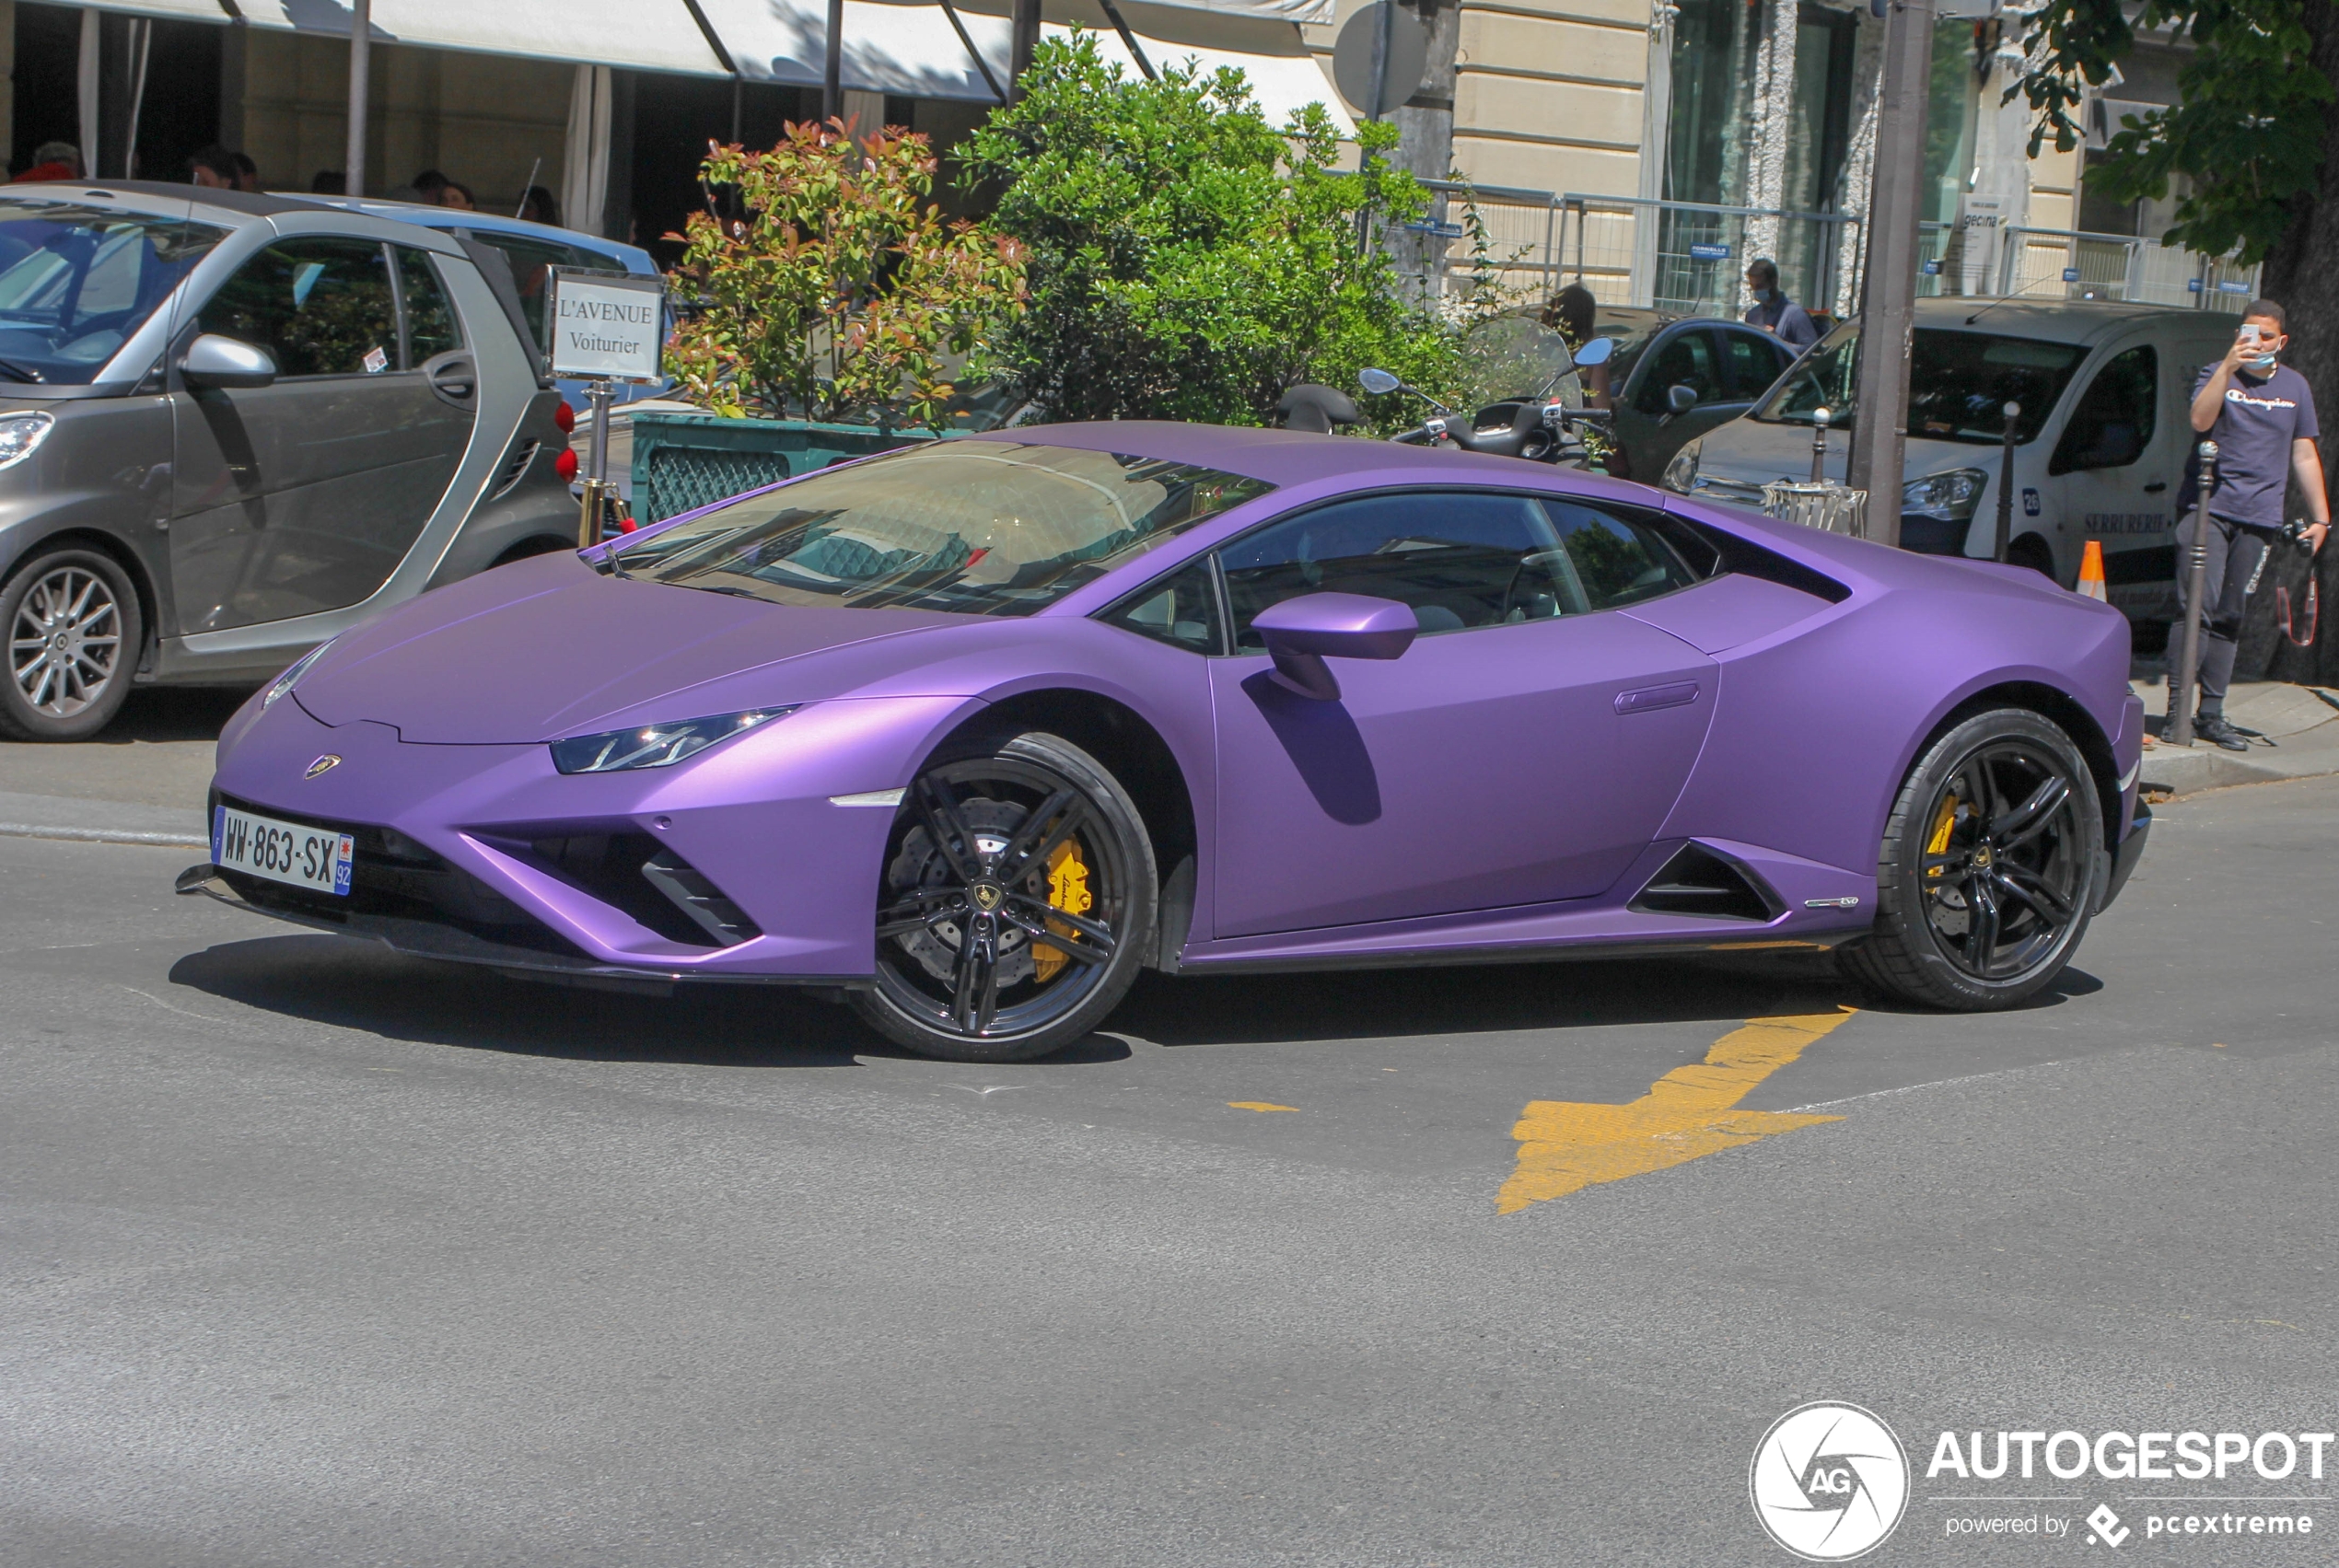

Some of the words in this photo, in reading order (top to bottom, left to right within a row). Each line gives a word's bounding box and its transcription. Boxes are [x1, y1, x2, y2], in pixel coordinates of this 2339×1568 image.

[1963, 214, 1997, 230] gecina
[559, 299, 653, 324] L'AVENUE
[570, 331, 640, 354] Voiturier
[2225, 389, 2297, 412] Champion
[2024, 494, 2039, 510] 26
[226, 817, 334, 883] WW-863-SX
[336, 865, 351, 886] 92
